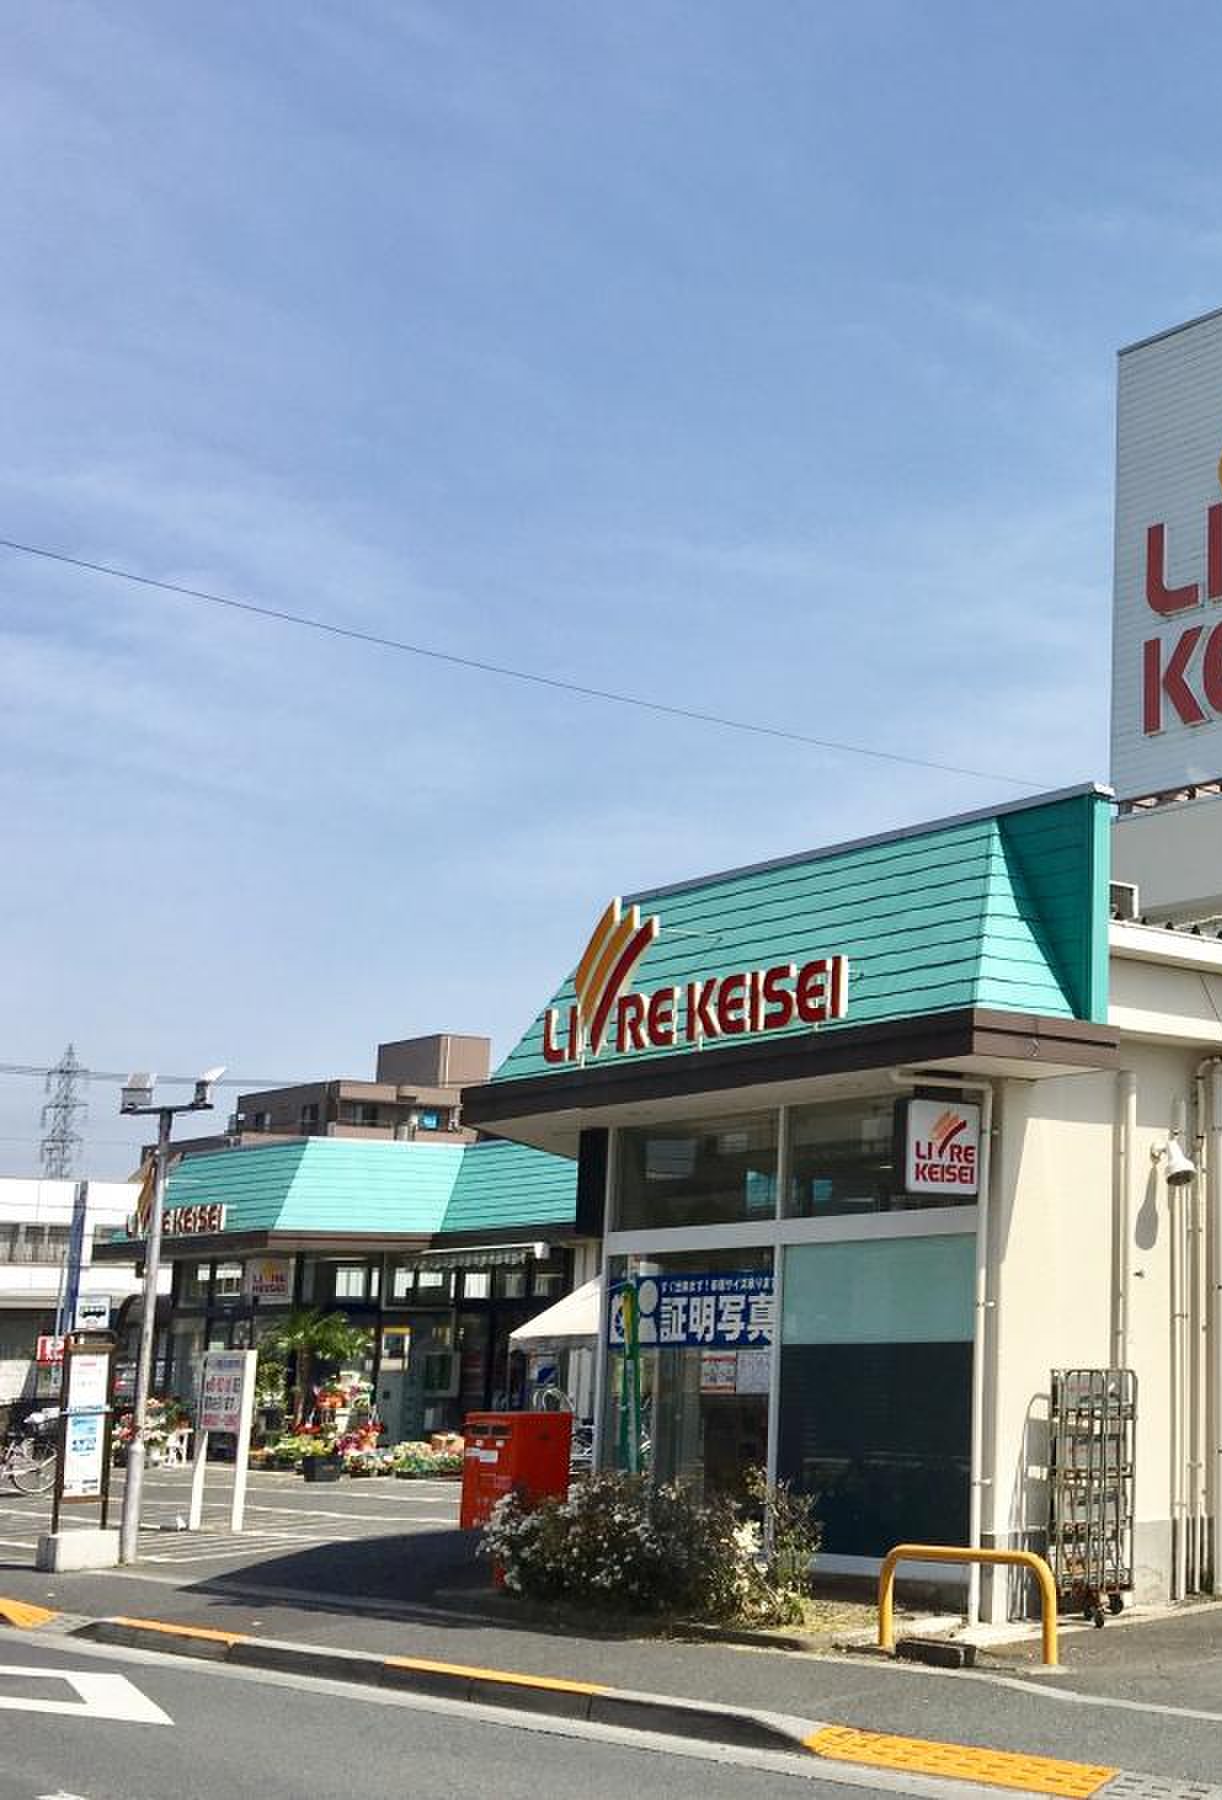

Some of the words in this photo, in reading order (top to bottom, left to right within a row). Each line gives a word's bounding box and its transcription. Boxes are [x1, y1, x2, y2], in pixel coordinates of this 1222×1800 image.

[686, 954, 848, 1042] KEISEI
[915, 1163, 975, 1185] KEISEI
[660, 1294, 774, 1342] 証明写真
